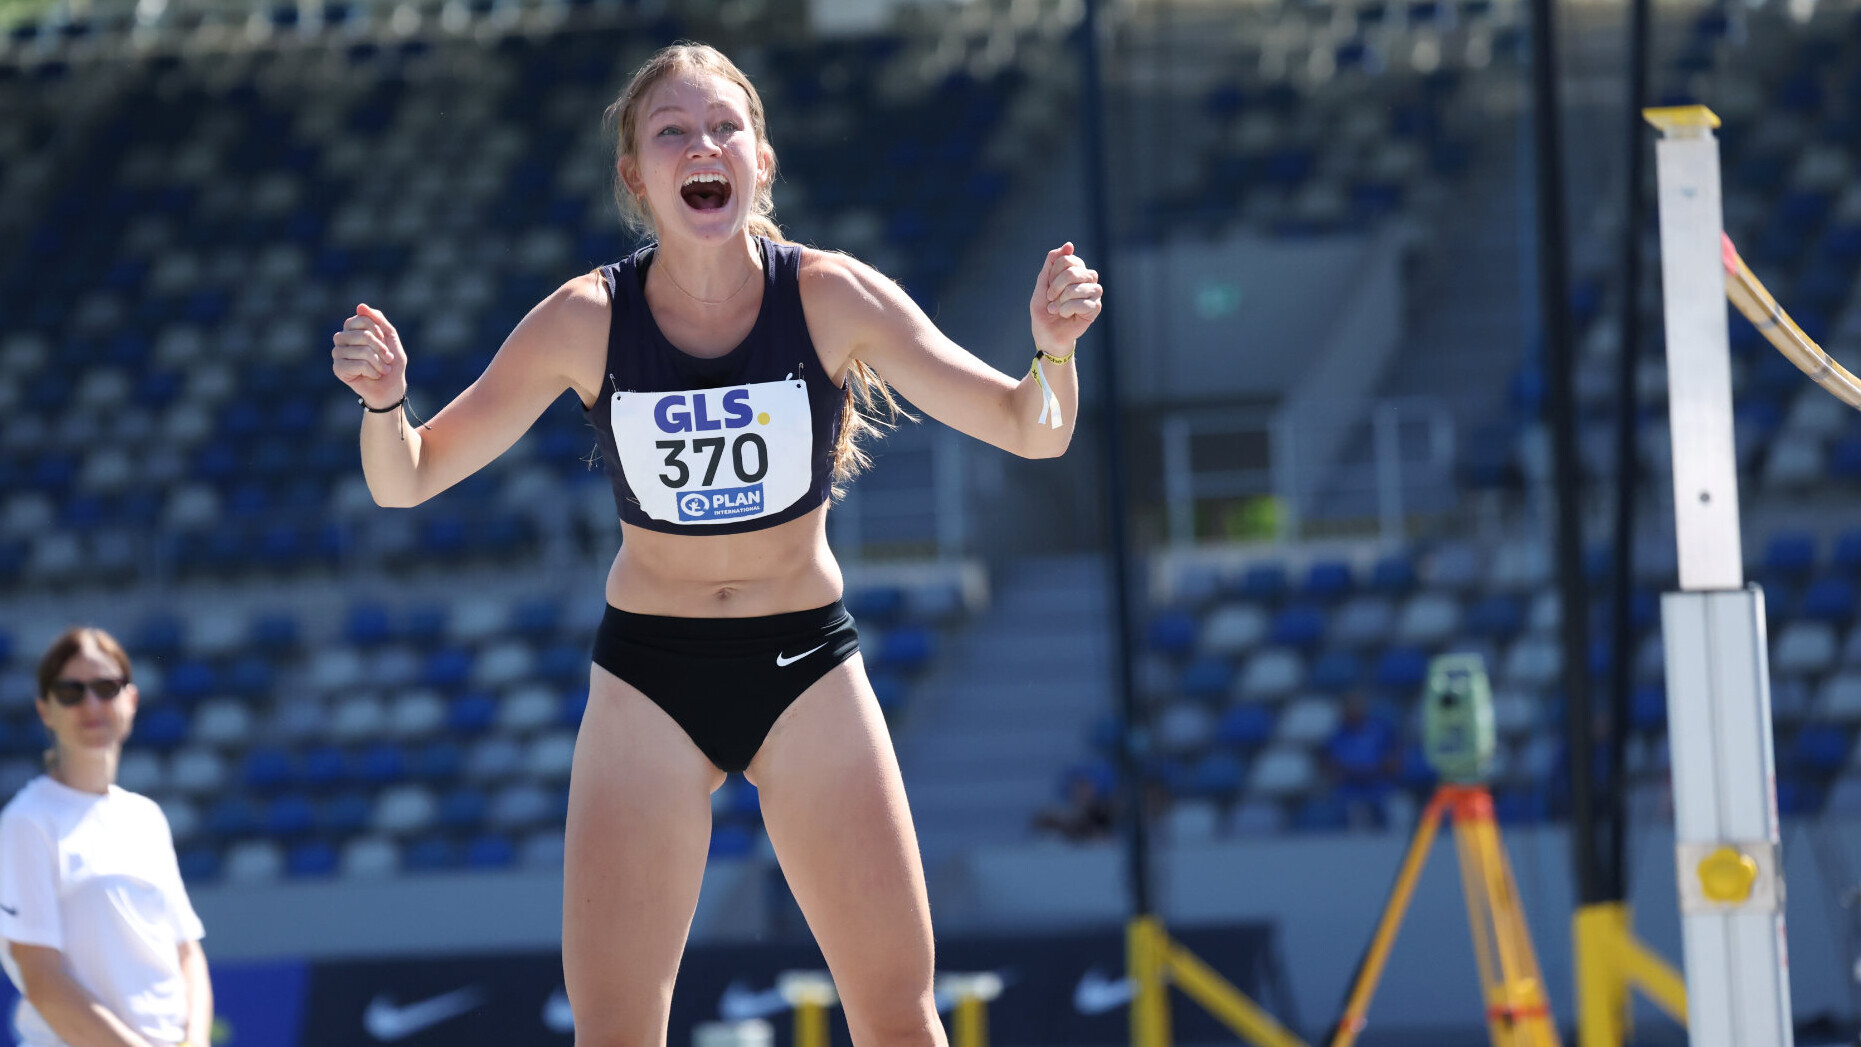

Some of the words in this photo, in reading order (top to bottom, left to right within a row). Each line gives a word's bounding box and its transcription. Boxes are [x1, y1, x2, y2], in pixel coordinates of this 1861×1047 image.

[655, 433, 768, 488] 370
[712, 490, 760, 508] PLAN
[714, 506, 760, 515] INTERNATIONAL
